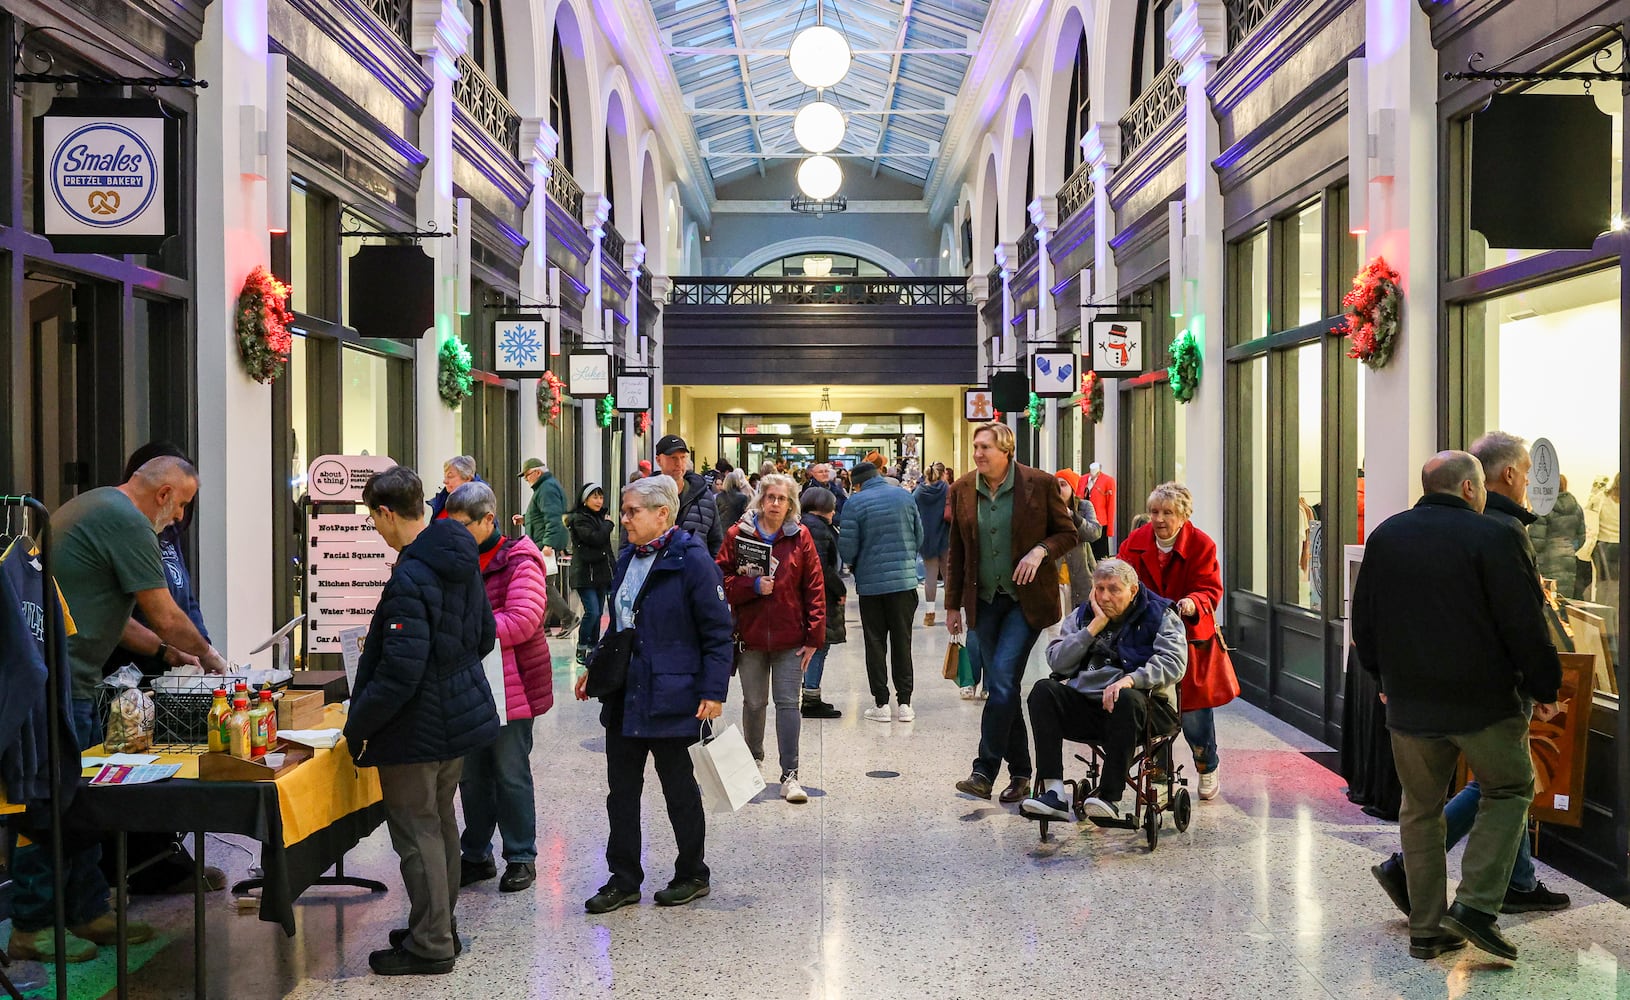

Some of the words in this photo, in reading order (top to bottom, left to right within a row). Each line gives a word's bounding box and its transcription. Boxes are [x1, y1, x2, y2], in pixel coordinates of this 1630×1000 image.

[63, 144, 142, 172] Smales
[65, 176, 102, 185] PRETZEL
[106, 177, 142, 185] BAKERY
[351, 552, 385, 560] Squares
